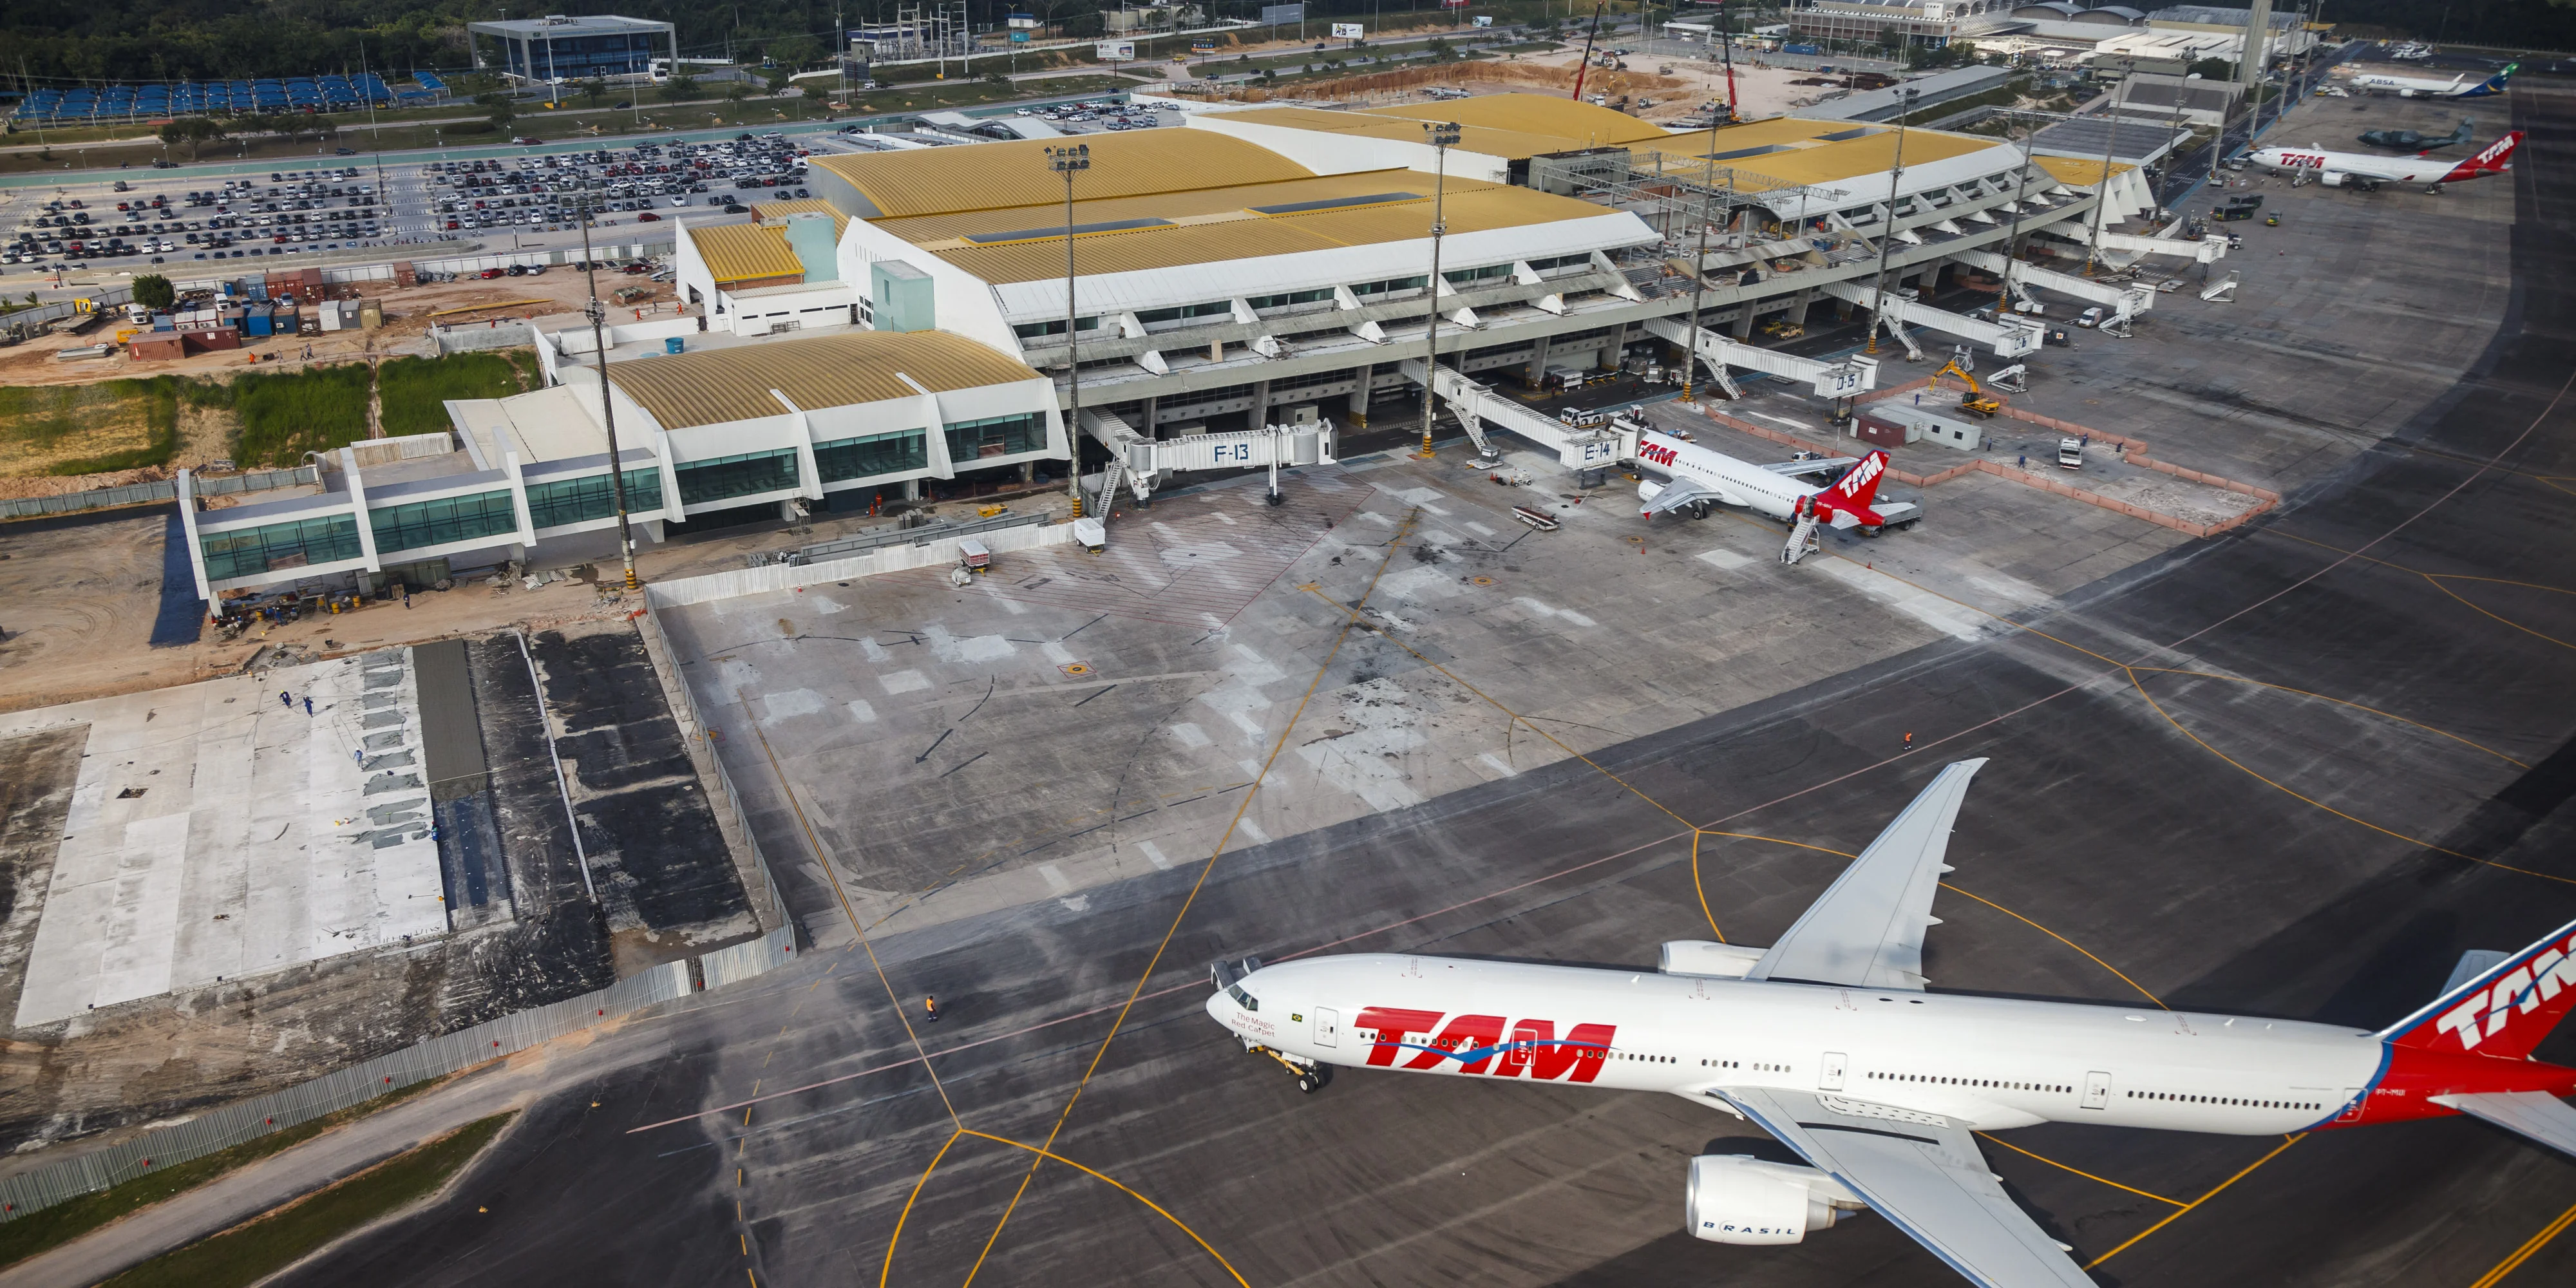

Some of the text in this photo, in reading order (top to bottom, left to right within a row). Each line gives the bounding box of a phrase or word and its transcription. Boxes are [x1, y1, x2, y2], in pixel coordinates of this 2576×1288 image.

[2477, 135, 2514, 164] TAM
[2280, 153, 2325, 169] TAM
[1837, 374, 1855, 390] D-15
[1215, 444, 1248, 462] F-13
[1585, 442, 1610, 460] E-14
[1639, 440, 1678, 467] TAM
[1839, 451, 1883, 498] TAM
[2436, 934, 2576, 1050] TAM
[1231, 1019, 1275, 1037] Red Carpet
[1236, 1012, 1275, 1030] The Magic
[1354, 1007, 1617, 1083] TAM
[1703, 1222, 1795, 1235] BRASIL
